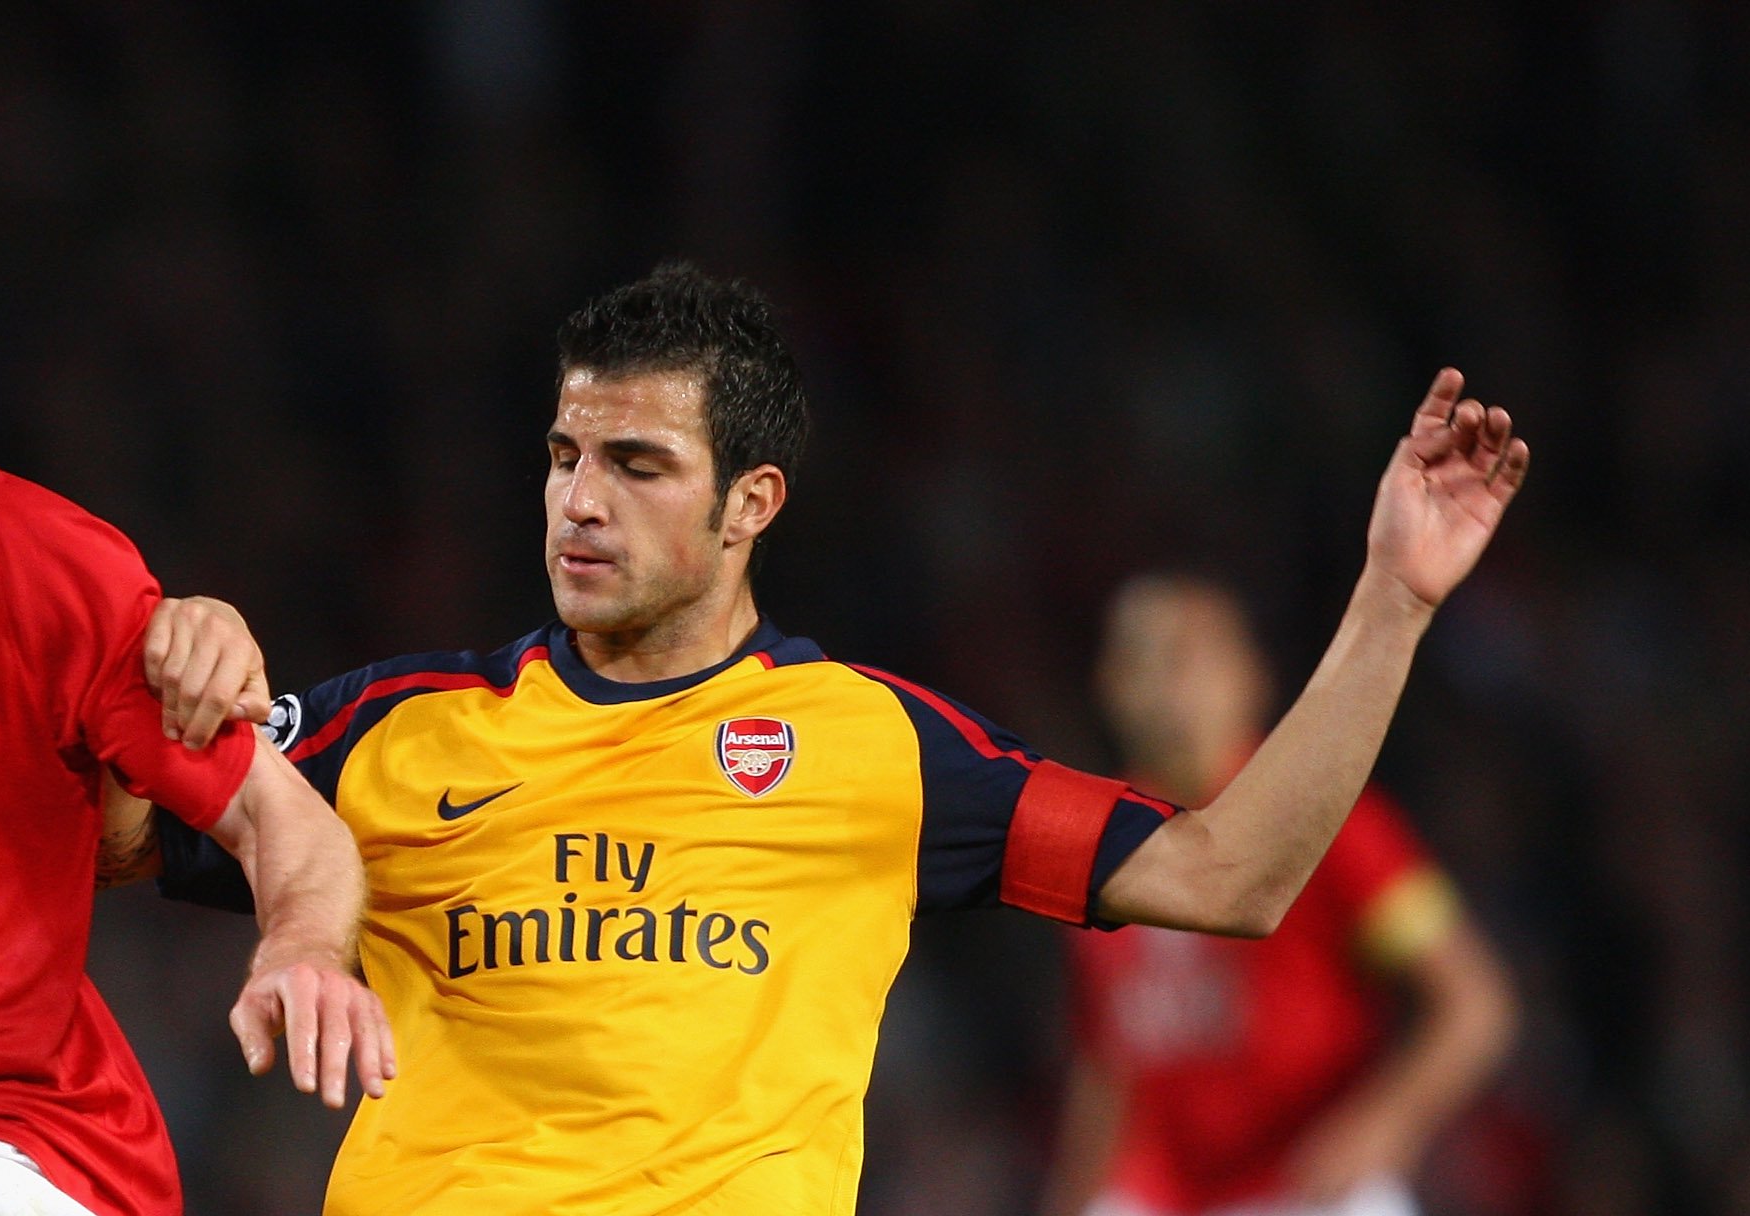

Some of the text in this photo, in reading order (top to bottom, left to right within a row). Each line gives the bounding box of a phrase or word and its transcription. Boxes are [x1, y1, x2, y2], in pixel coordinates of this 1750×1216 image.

[726, 732, 784, 745] Arsenal
[554, 832, 654, 892] Fly
[445, 892, 770, 979] Emirates
